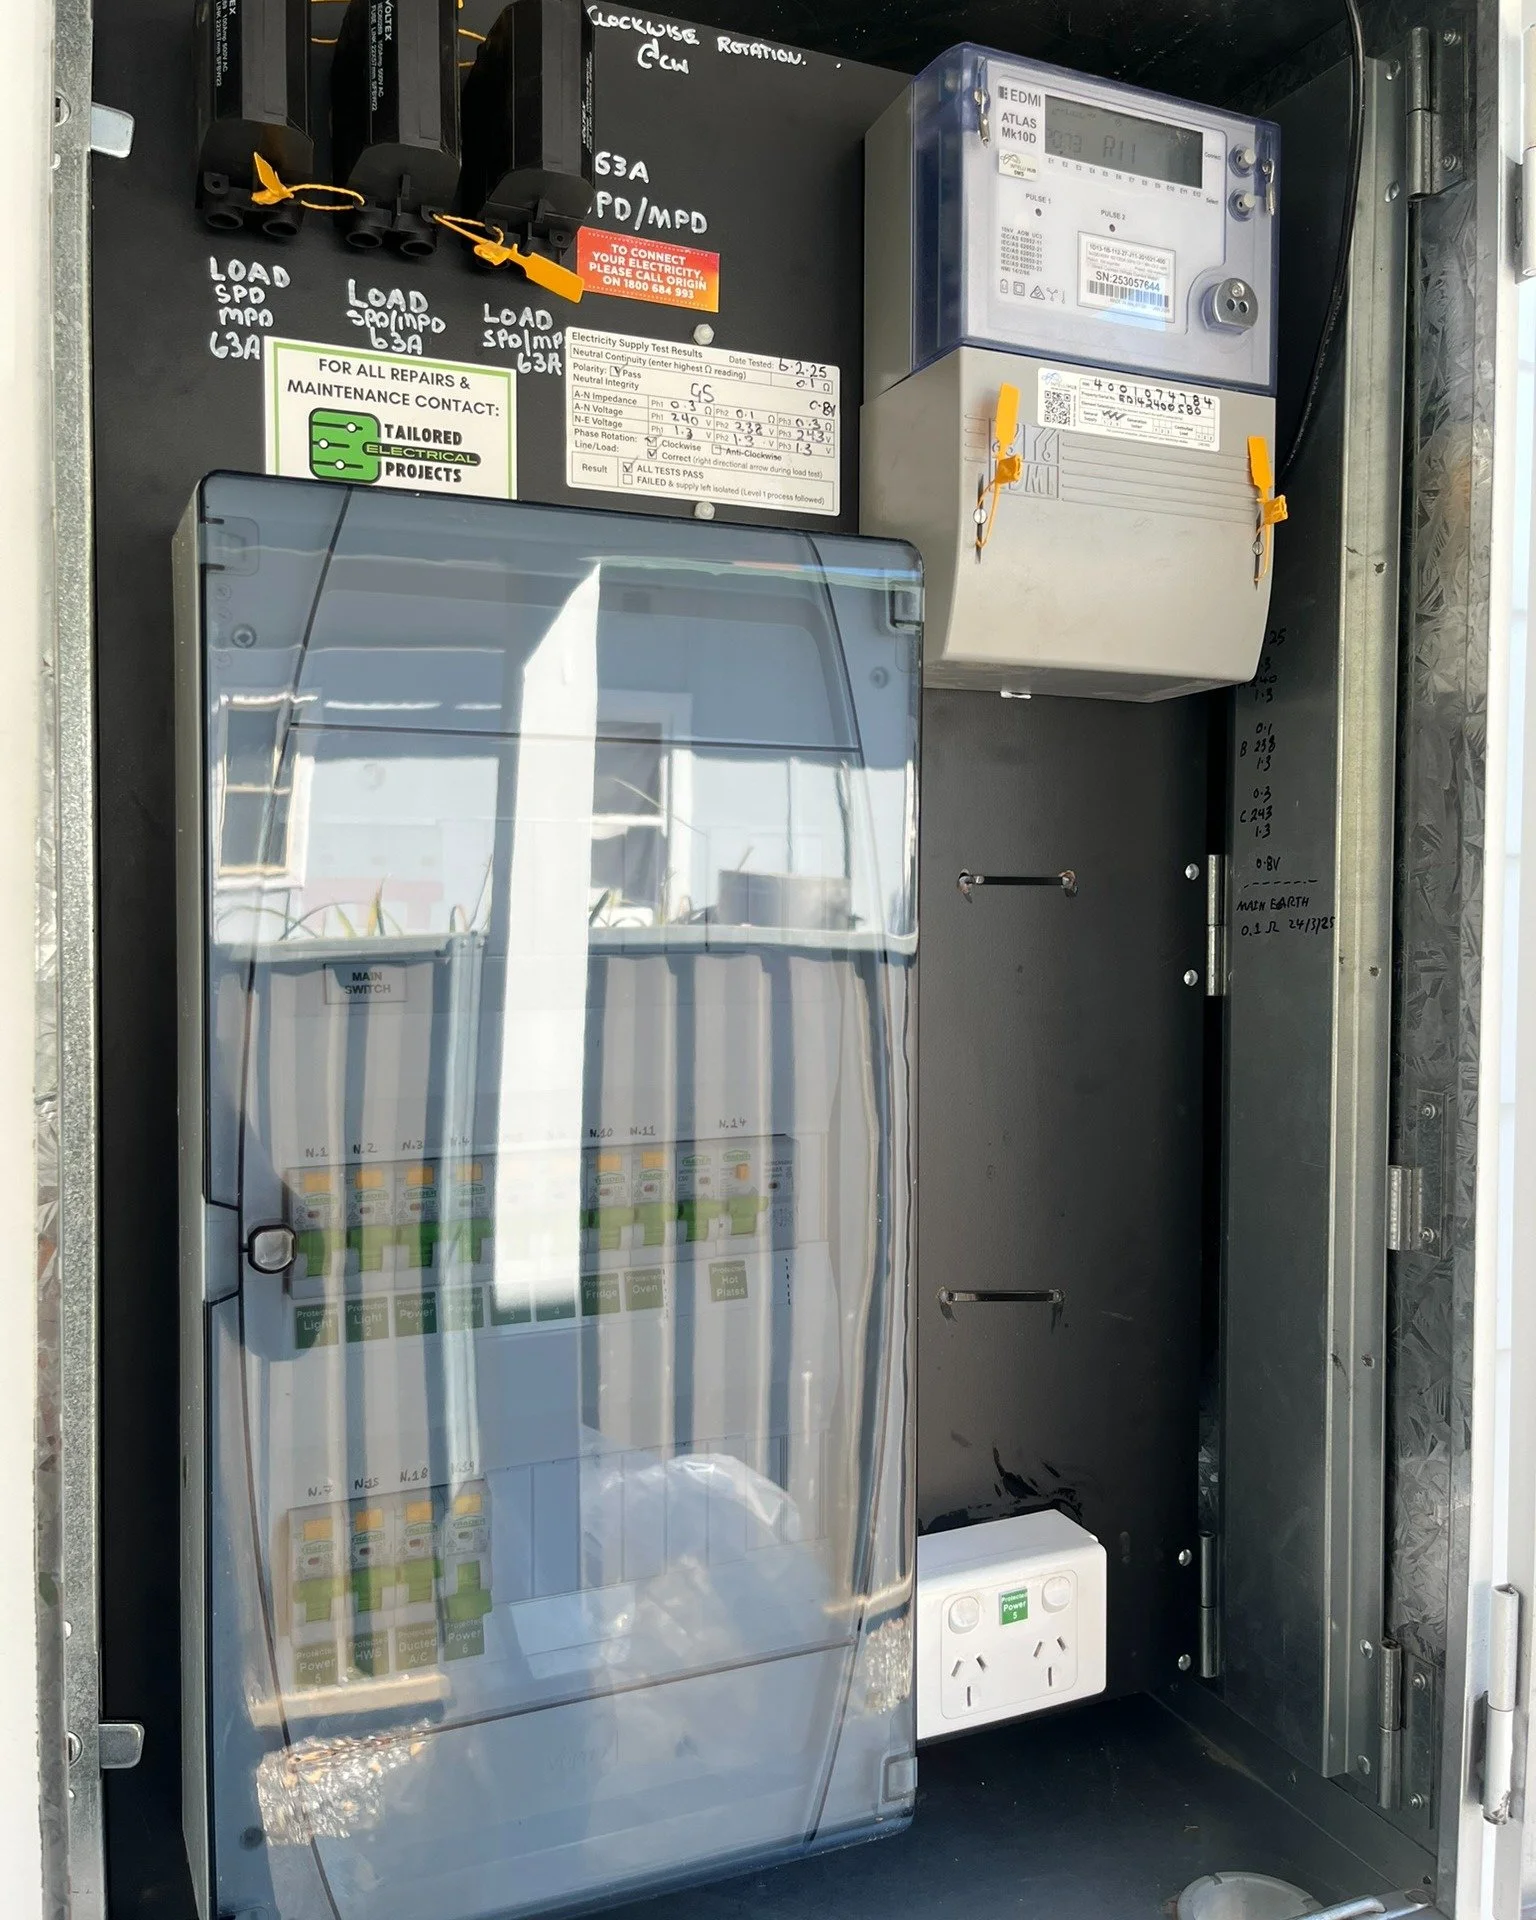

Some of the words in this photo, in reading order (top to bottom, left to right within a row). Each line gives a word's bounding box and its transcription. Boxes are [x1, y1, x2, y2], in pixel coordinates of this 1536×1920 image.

[384, 0, 394, 40] VOLTEX
[586, 5, 700, 45] CLOCKWISE
[1010, 89, 1041, 107] EDMI
[1002, 112, 1037, 129] ATLAS
[1002, 127, 1036, 144] Mk10D
[595, 151, 650, 184] 63A
[1026, 193, 1046, 204] PULSE
[587, 190, 708, 234] PD/MPD
[1100, 209, 1120, 220] PULSE
[592, 251, 625, 266] YOUR
[611, 244, 627, 255] TO
[631, 248, 686, 266] CONNECT
[209, 256, 291, 288] LOAD
[589, 262, 632, 278] PLEASE
[636, 271, 663, 283] CALL
[666, 276, 707, 290] ORIGIN
[1096, 270, 1160, 292] SN:253057644
[214, 284, 266, 304] SPD
[348, 279, 428, 313] LOAD
[602, 276, 620, 286] ON
[624, 279, 649, 291] 1800
[652, 284, 672, 295] 684
[676, 288, 694, 299] 993
[484, 303, 554, 330] LOAD
[209, 330, 260, 360] 63A
[370, 327, 423, 355] 63A
[572, 332, 616, 347] Electricity
[620, 339, 649, 352] Supply
[651, 344, 668, 353] Test
[672, 347, 702, 358] Results
[729, 356, 746, 364] Date
[748, 359, 774, 369] Tested:
[517, 352, 562, 376] 63A
[573, 348, 603, 358] Neutral
[605, 352, 647, 366] Continuity
[648, 358, 671, 368] (enter
[674, 362, 702, 373] highest
[715, 368, 746, 380] reading)
[573, 362, 607, 374] Polarity:
[622, 370, 641, 378] Pass
[319, 358, 350, 376] FOR
[357, 364, 387, 380] ALL
[390, 368, 455, 388] REPAIRS
[459, 376, 470, 390] &
[573, 374, 603, 385] Neutral
[605, 378, 639, 391] Integrity
[287, 379, 410, 406] MAINTENANCE
[415, 395, 500, 418] CONTACT:
[574, 391, 590, 399] A-N
[593, 392, 637, 405] Impedance
[574, 403, 590, 411] A-N
[592, 404, 623, 417] Voltage
[671, 413, 698, 426] 240
[797, 430, 824, 442] 243
[592, 417, 622, 429] Voltage
[384, 424, 463, 446] TAILORED
[574, 428, 599, 438] Phase
[602, 432, 637, 443] Rotation:
[662, 440, 701, 451] Clockwise
[366, 444, 477, 464] ELECTRICAL
[575, 441, 619, 452] Line/Load:
[662, 452, 691, 463] Correct
[693, 457, 711, 466] (right
[713, 457, 747, 469] directional
[750, 464, 768, 472] arrow
[770, 466, 791, 476] during
[793, 468, 806, 476] load
[808, 469, 823, 479] test)
[386, 461, 462, 483] PROJECTS
[582, 463, 607, 474] Result
[637, 465, 652, 473] ALL
[655, 467, 680, 476] TESTS
[683, 470, 704, 479] PASS
[637, 477, 666, 486] FAILED
[676, 482, 699, 491] supply
[700, 484, 712, 492] left
[714, 485, 739, 495] isolated
[741, 487, 761, 497] (Level
[768, 491, 793, 500] process
[794, 493, 824, 505] followed)
[1240, 741, 1248, 757] B
[1240, 810, 1246, 823] C
[1250, 805, 1272, 822] 243
[1236, 900, 1266, 912] MAIN
[1270, 896, 1309, 910] EARTH
[352, 972, 382, 981] MAIN
[345, 984, 391, 994] SWITCH
[722, 1275, 739, 1284] Hot
[586, 1289, 617, 1299] Fridge
[632, 1284, 658, 1294] Oven
[716, 1287, 745, 1297] Plates
[355, 1314, 382, 1324] Light
[400, 1309, 434, 1319] Power
[304, 1320, 333, 1332] Light
[366, 1327, 372, 1336] 2
[1004, 1601, 1026, 1612] Power
[1013, 1612, 1017, 1620] 5
[449, 1630, 482, 1641] Power
[462, 1645, 469, 1654] 6
[300, 1658, 336, 1672] Power
